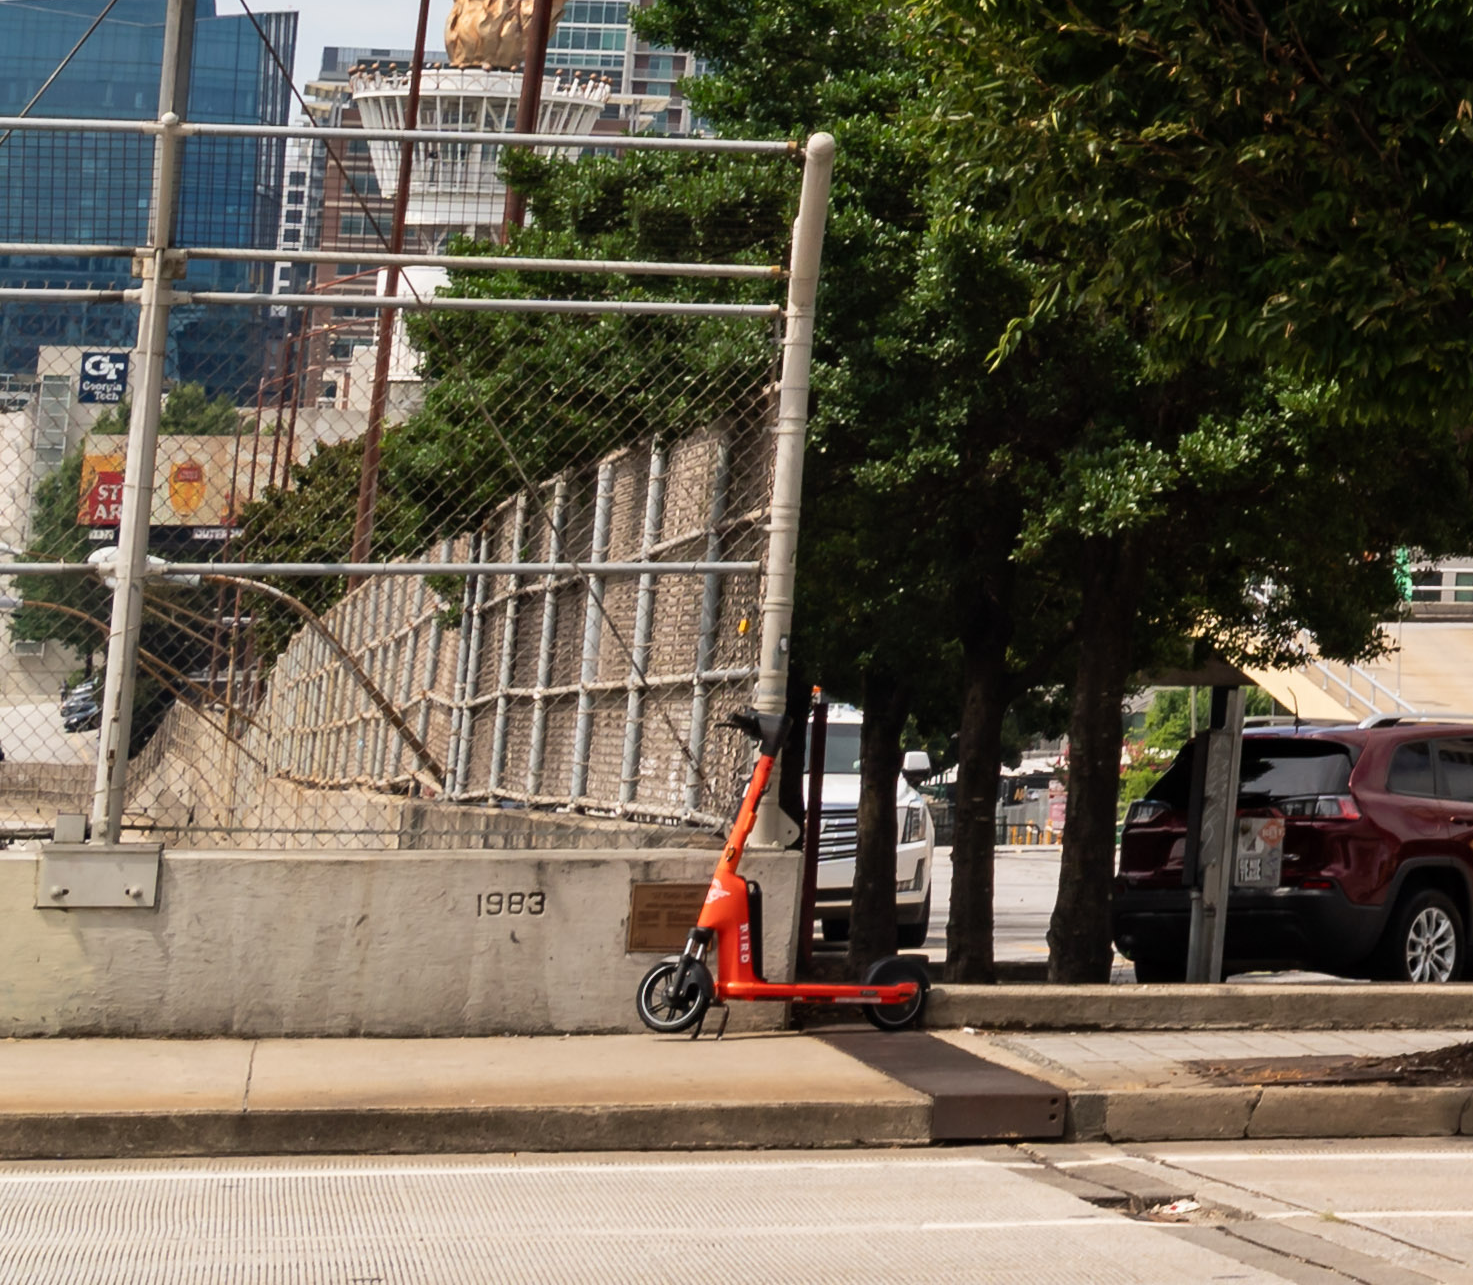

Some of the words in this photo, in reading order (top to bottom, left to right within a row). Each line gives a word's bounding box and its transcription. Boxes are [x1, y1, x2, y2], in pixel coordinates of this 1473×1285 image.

[82, 381, 122, 394] Georgia
[94, 391, 119, 401] Tech
[476, 891, 546, 917] 1983
